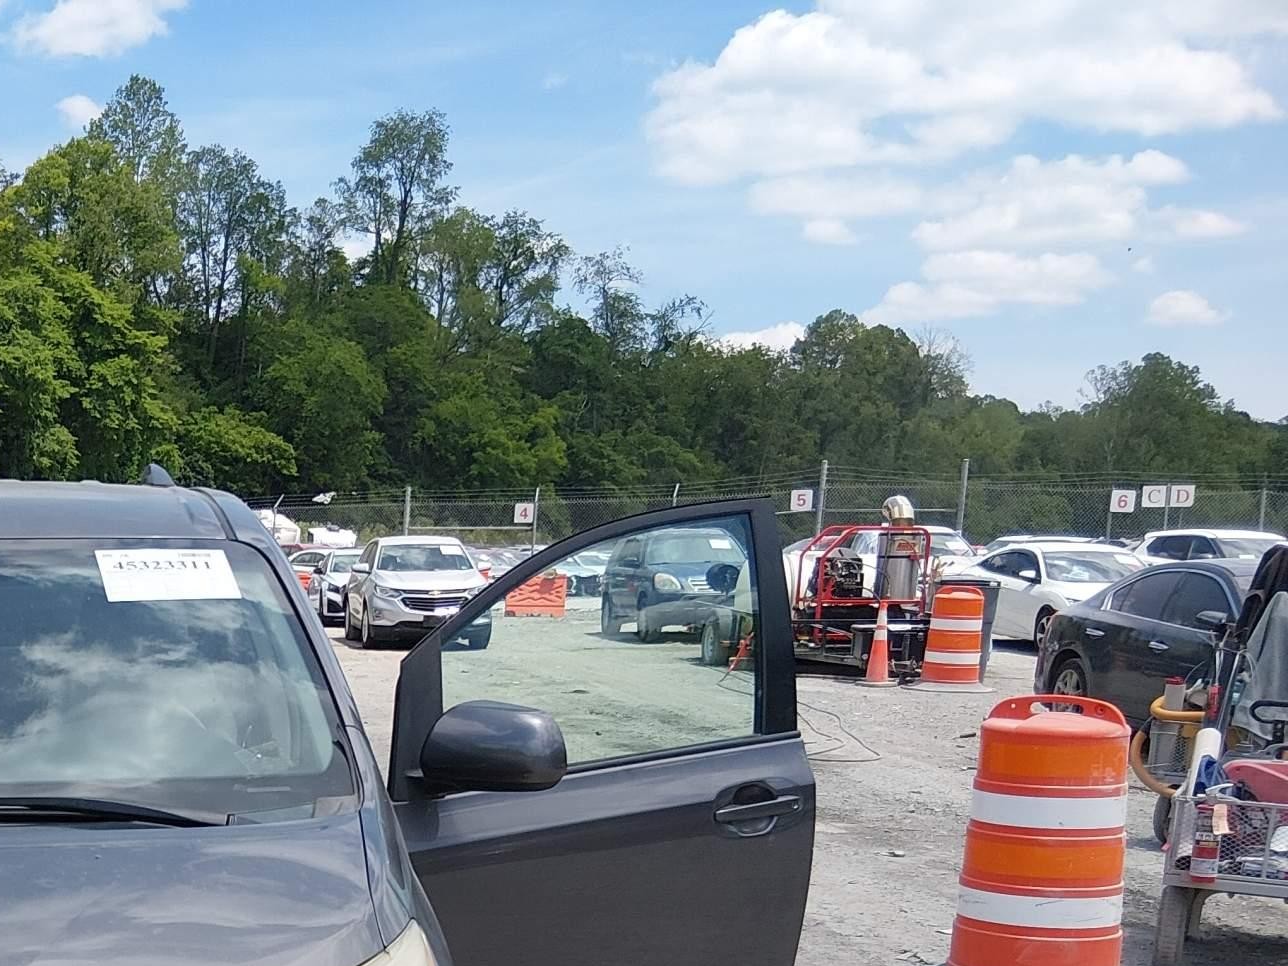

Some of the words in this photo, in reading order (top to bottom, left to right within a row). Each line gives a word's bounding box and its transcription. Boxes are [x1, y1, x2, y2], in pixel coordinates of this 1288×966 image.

[797, 494, 806, 507] 5
[1117, 494, 1128, 508] 6
[1148, 489, 1161, 503] C
[1176, 489, 1189, 503] D
[519, 507, 529, 520] 4
[113, 560, 211, 570] 45323311
